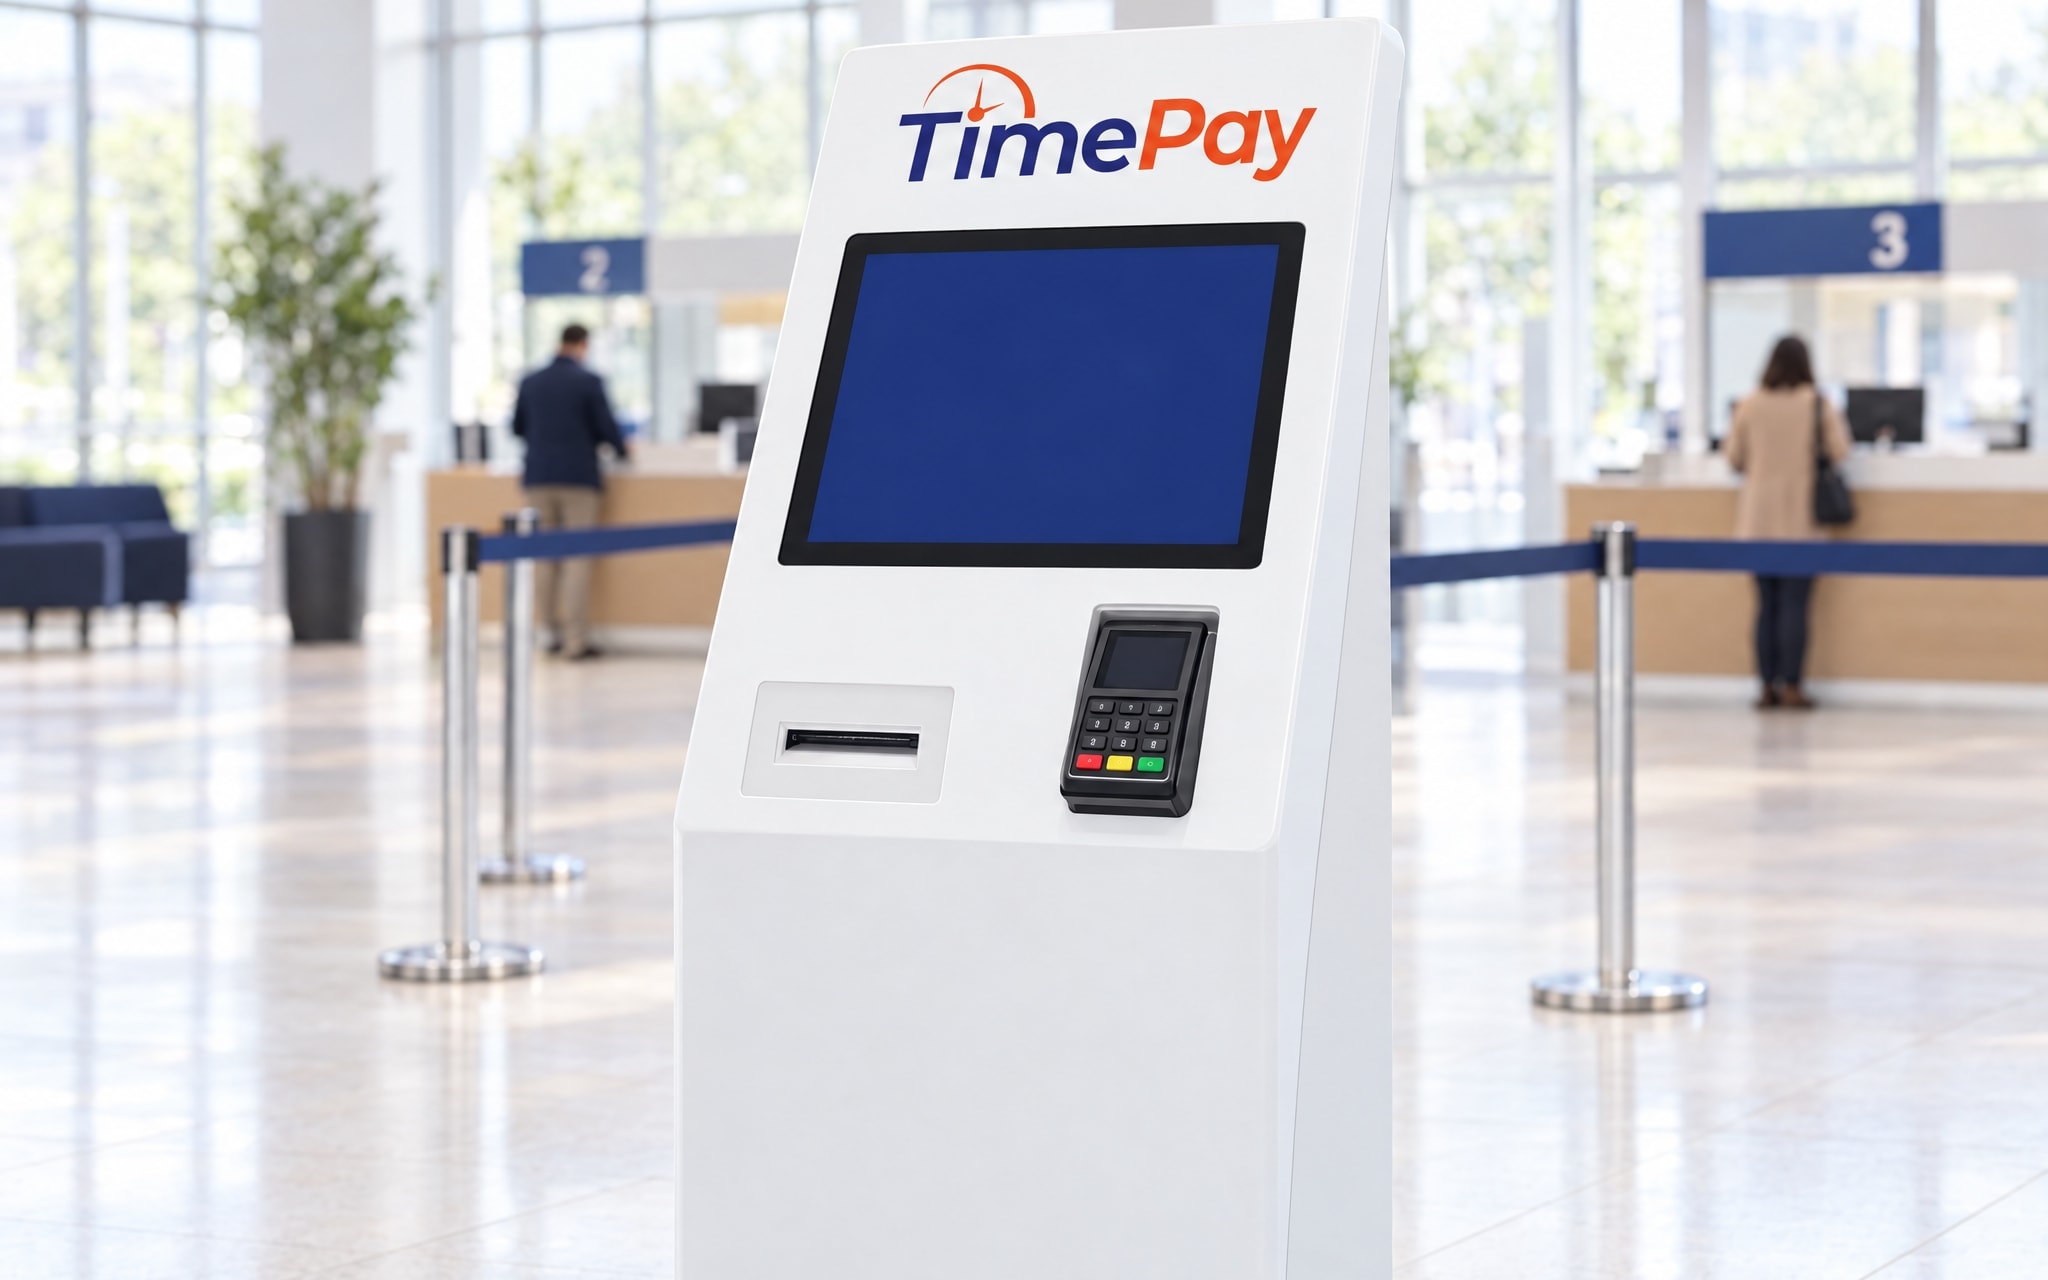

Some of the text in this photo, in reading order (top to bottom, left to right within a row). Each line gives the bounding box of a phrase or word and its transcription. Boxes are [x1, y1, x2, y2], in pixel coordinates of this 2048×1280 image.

[899, 98, 1318, 182] TimePay
[578, 245, 610, 292] 2
[1869, 210, 1909, 270] 3
